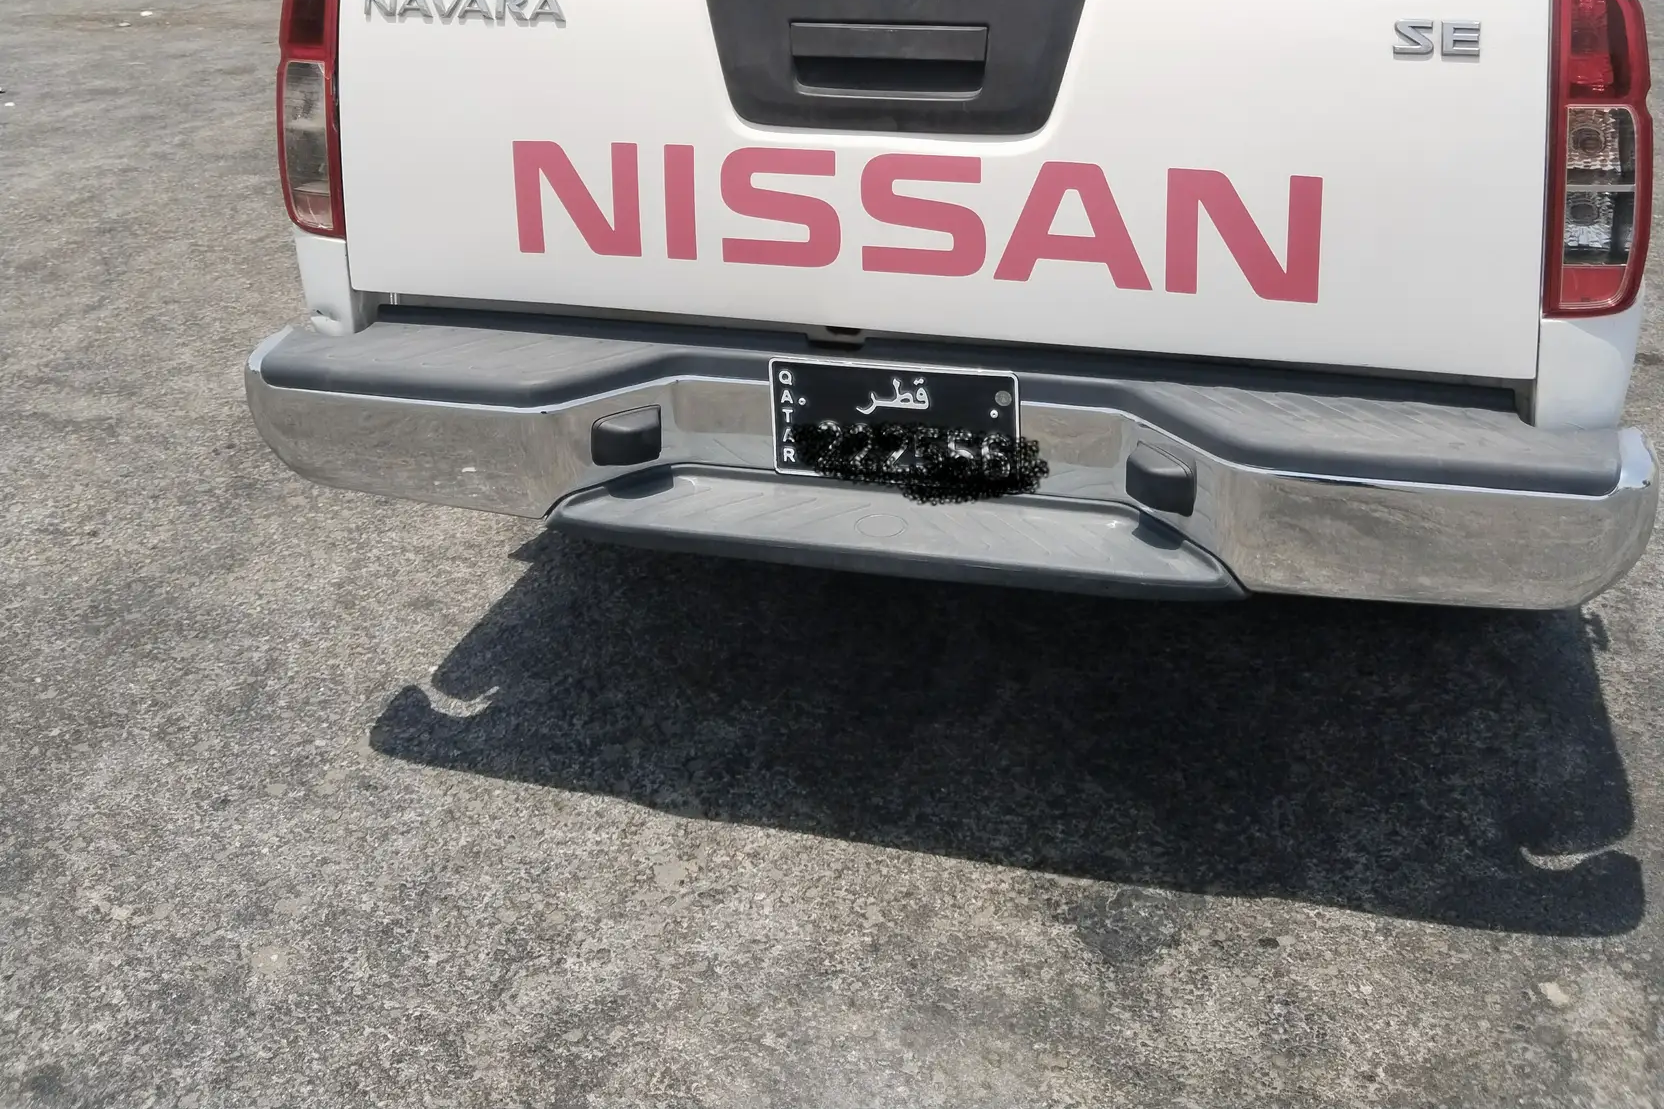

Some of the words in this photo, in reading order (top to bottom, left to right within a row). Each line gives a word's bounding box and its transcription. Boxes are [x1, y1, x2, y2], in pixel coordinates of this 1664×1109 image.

[1392, 18, 1481, 57] SE
[512, 140, 1324, 304] NISSAN
[777, 370, 796, 463] QATAR
[856, 377, 930, 415] قطر
